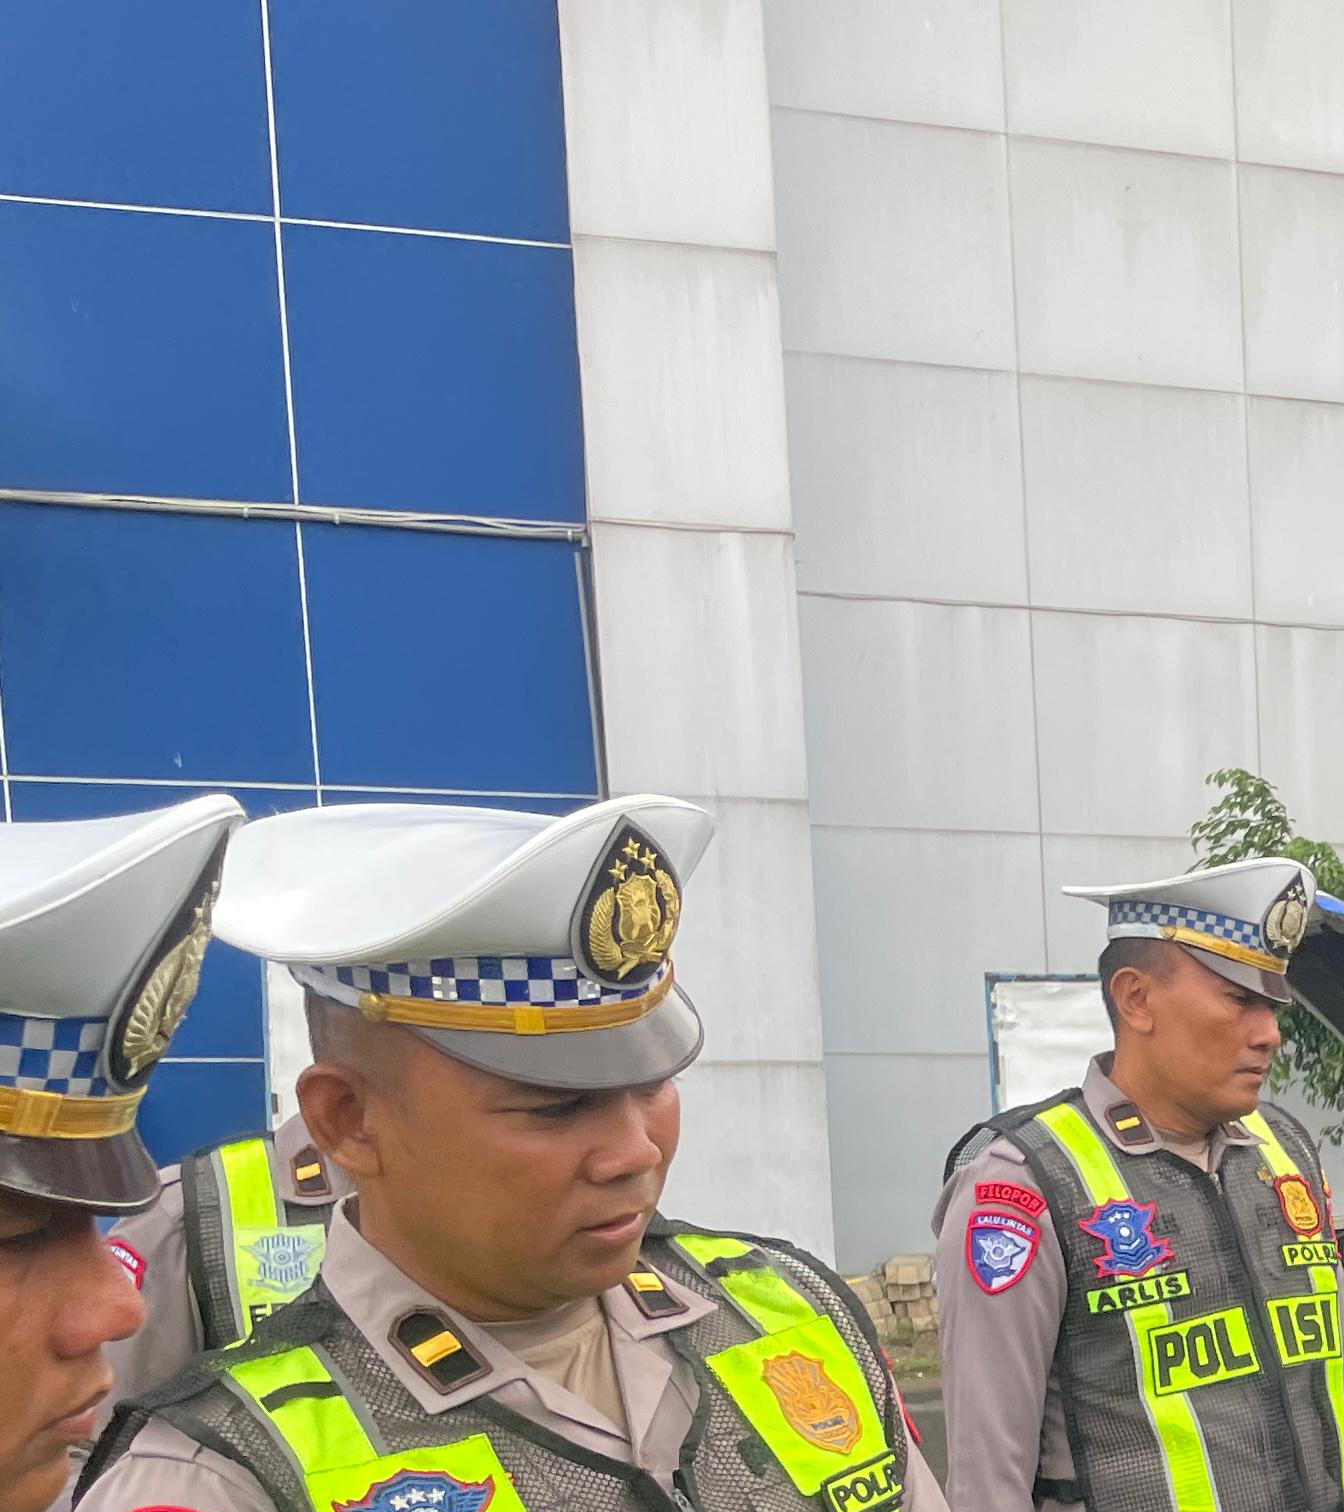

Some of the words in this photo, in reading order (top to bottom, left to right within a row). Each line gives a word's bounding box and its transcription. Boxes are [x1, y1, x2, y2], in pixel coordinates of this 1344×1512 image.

[979, 1185, 1041, 1211] PELOPOR
[976, 1215, 999, 1225] LALU
[1097, 1276, 1184, 1311] ARLIS
[1155, 1317, 1254, 1388] POL
[1276, 1300, 1336, 1357] ISI
